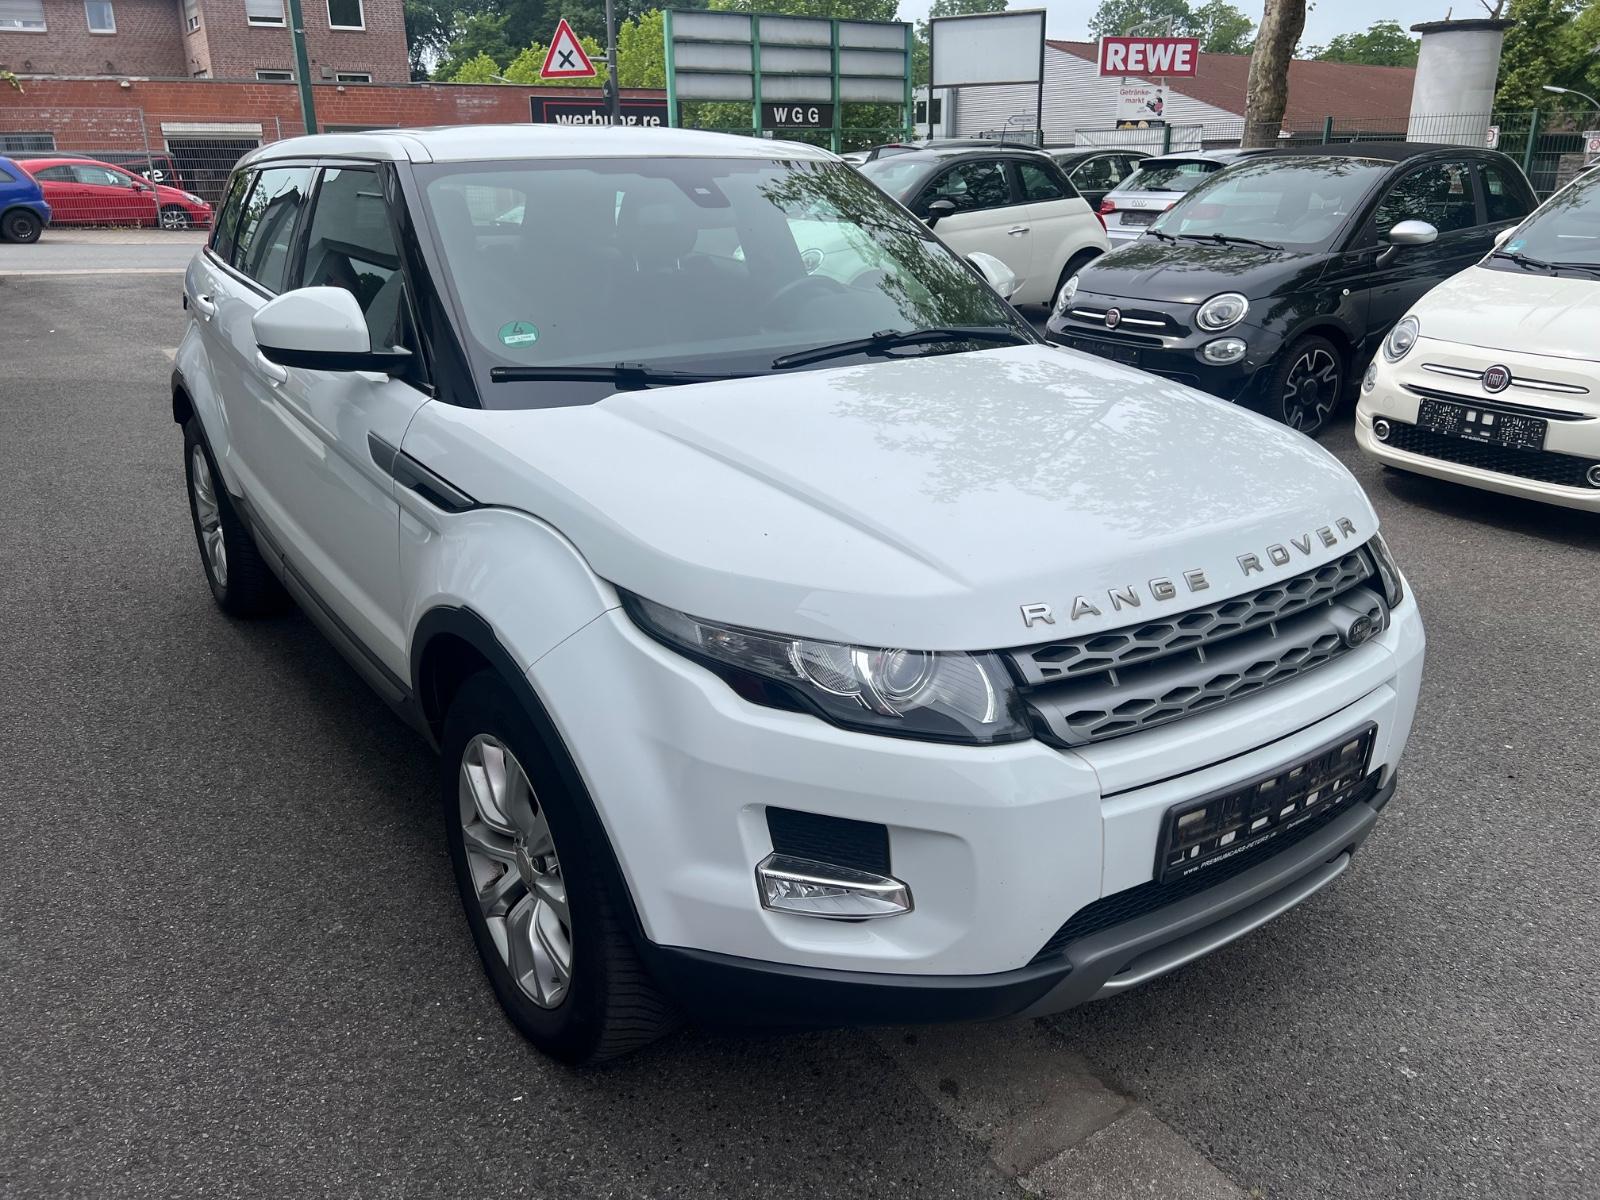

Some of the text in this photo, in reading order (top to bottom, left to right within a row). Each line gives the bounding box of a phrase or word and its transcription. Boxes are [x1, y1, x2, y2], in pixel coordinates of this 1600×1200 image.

[1106, 43, 1192, 73] REWE
[1125, 96, 1145, 104] markt
[513, 322, 524, 335] 4
[1487, 373, 1503, 386] FIAT
[1020, 516, 1357, 627] RANGE ROVER
